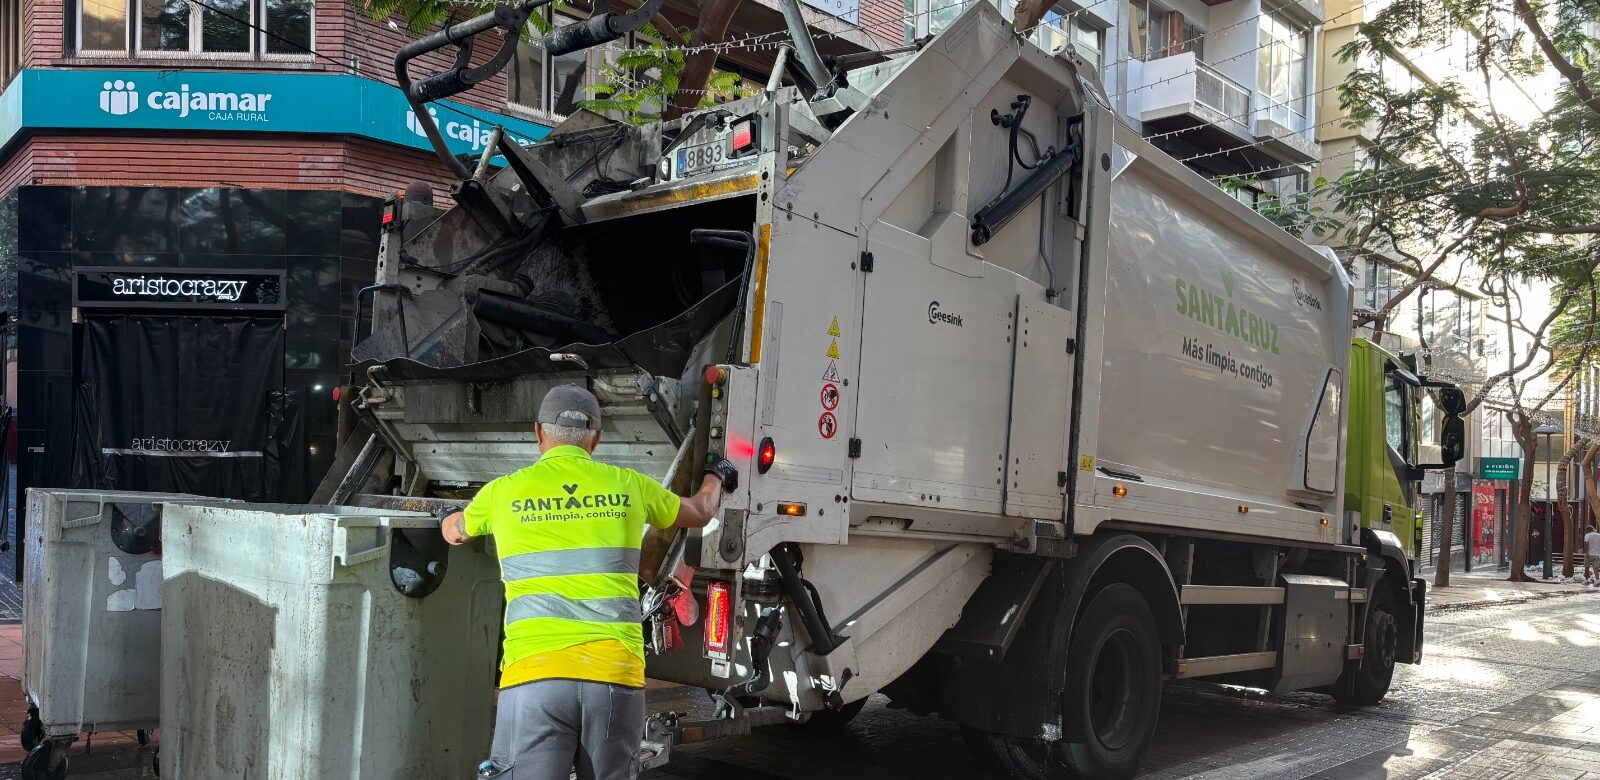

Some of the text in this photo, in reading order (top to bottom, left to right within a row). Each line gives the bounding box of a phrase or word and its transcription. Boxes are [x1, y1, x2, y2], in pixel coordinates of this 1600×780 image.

[147, 84, 272, 118] cajamar
[208, 112, 269, 122] CAJA RURAL
[446, 119, 538, 151] cajaa
[687, 145, 722, 169] 8893
[112, 275, 248, 301] aristocrazy
[928, 300, 963, 328] Geesink
[1182, 336, 1273, 389] Más limpia, contigo
[131, 436, 231, 456] aristocrazy
[520, 509, 627, 523] Más limpia, contigo
